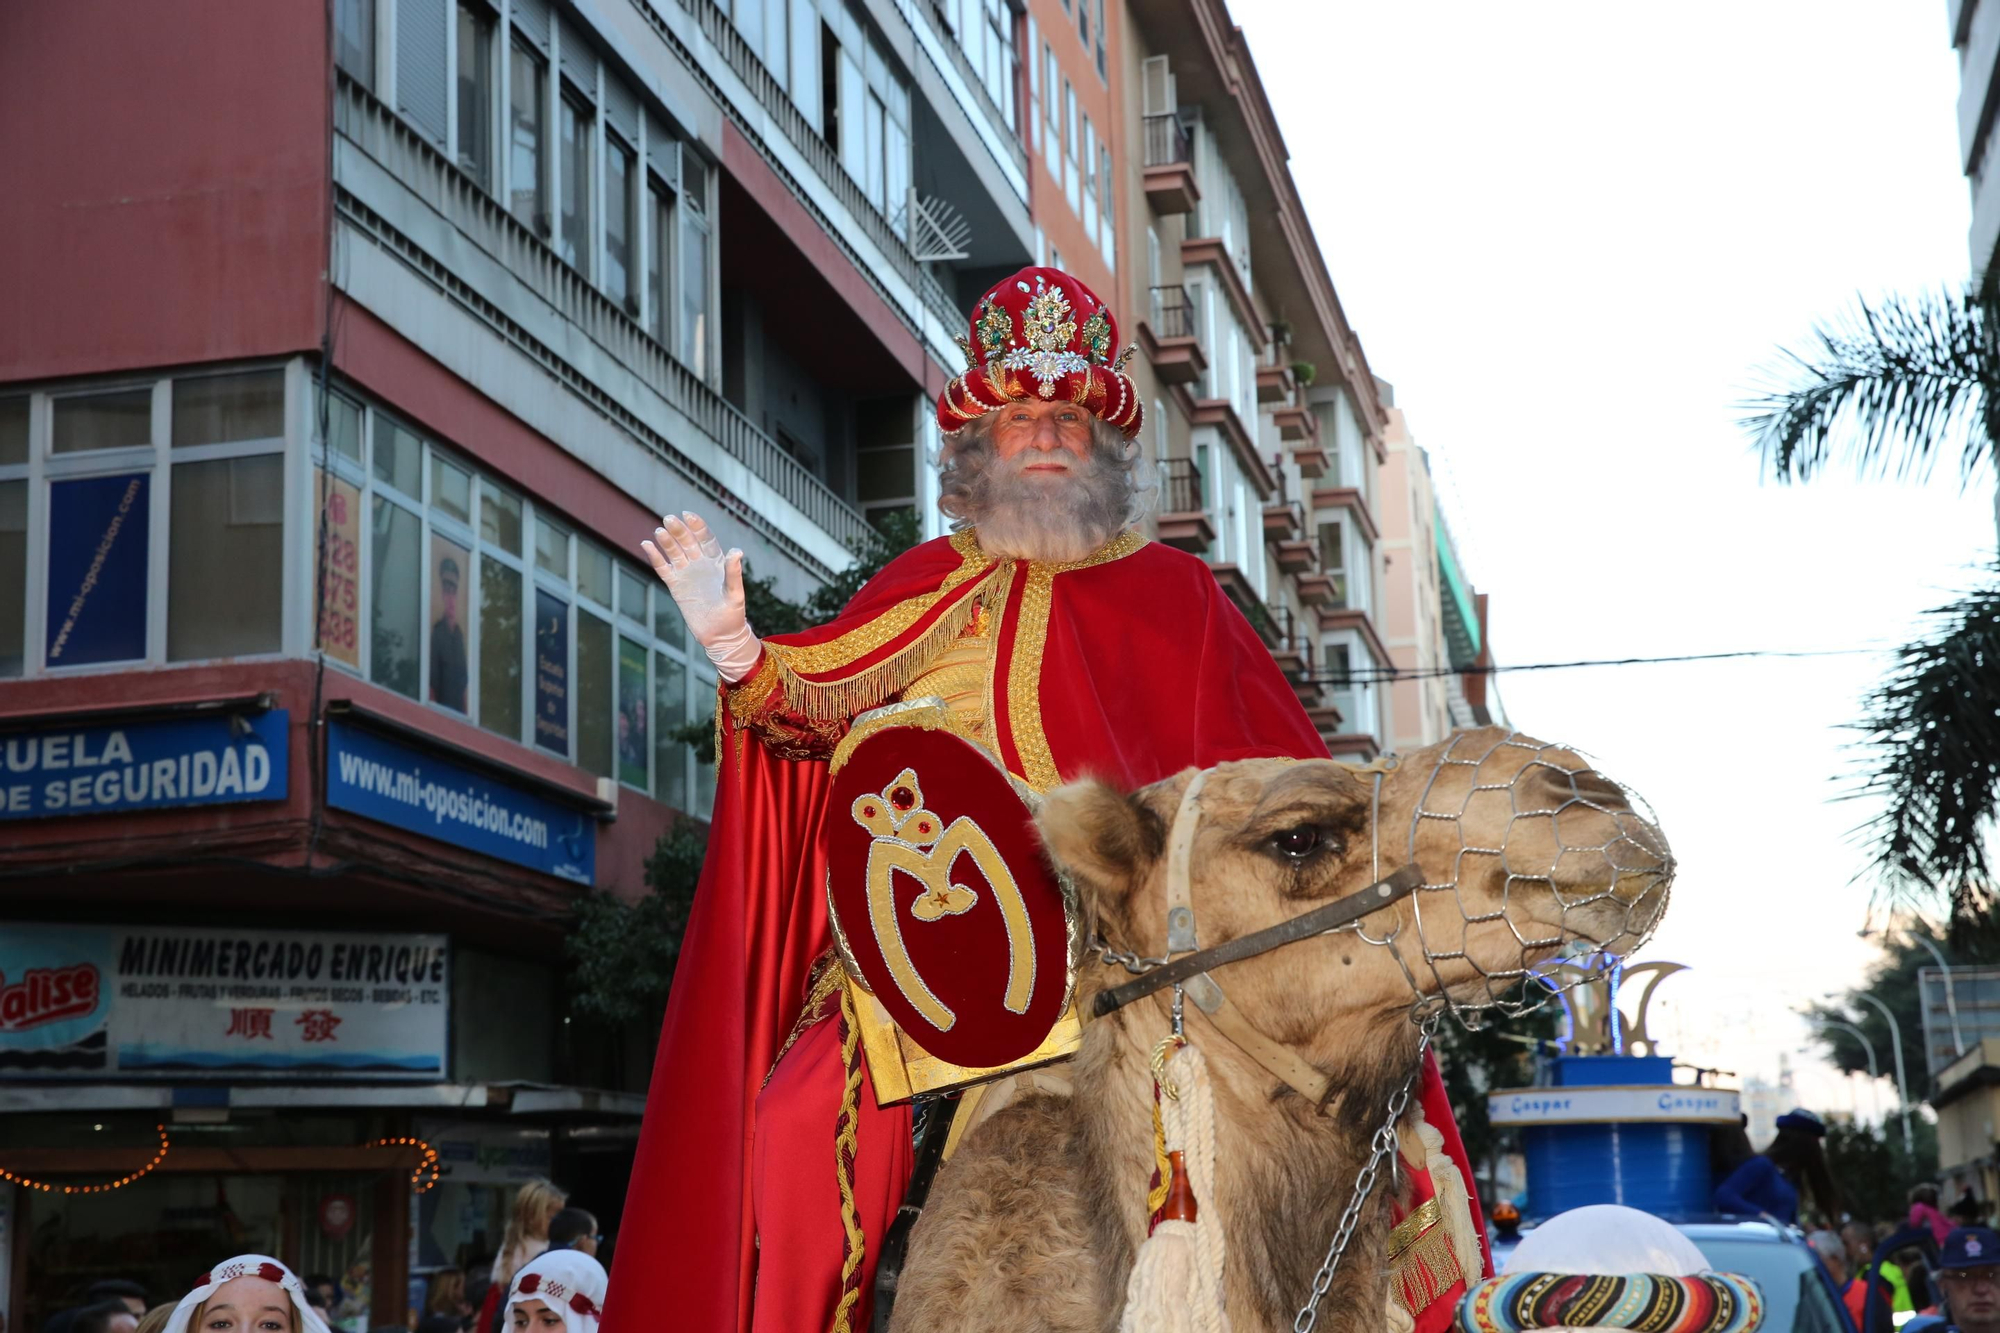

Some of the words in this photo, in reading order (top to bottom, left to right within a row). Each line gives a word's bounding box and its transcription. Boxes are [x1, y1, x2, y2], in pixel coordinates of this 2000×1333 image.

[50, 479, 140, 658] www.mi-oposicion.com
[0, 731, 133, 772] UELA
[44, 744, 270, 809] SEGURIDAD
[339, 751, 547, 849] www.mi-oposicion.com
[119, 936, 323, 980] MINIMERCADO
[331, 943, 444, 984] ENRIQUE
[0, 964, 98, 1031] alise
[121, 982, 169, 999] HELADOS
[178, 983, 217, 1000] FRUTAS
[228, 985, 281, 1000] VERDURAS
[290, 986, 329, 1002] FRUTOS
[331, 987, 364, 1003] SECOS
[373, 988, 412, 1004] BEBIDAS
[1511, 1098, 1571, 1115] Gaspar
[1657, 1092, 1719, 1112] Gaspar
